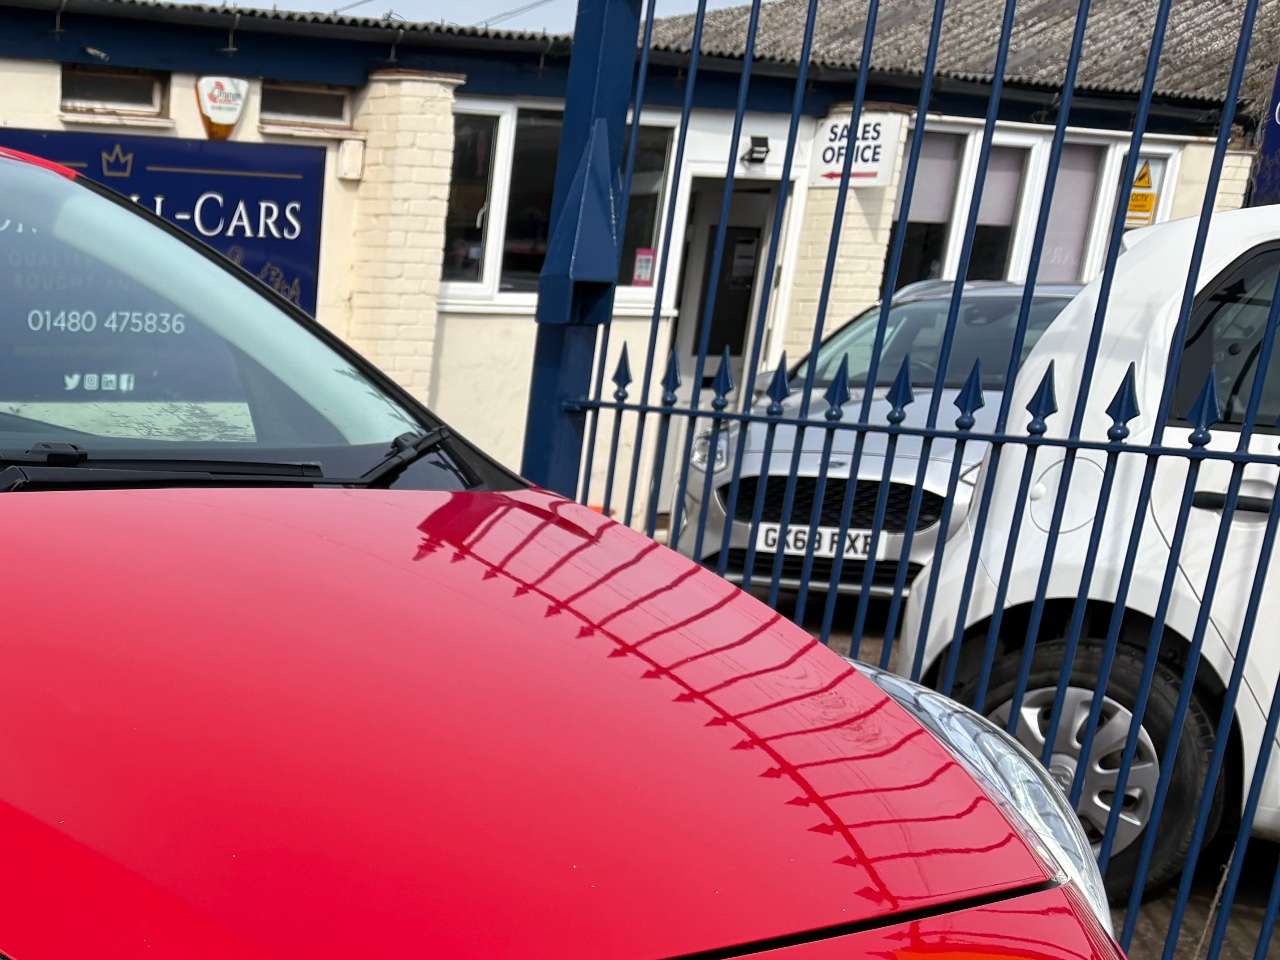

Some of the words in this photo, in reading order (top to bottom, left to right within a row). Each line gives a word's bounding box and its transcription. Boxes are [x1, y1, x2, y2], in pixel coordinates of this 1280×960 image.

[828, 122, 882, 142] SAES
[822, 144, 882, 164] OFICE
[27, 309, 97, 332] 01480
[104, 311, 185, 334] 475836
